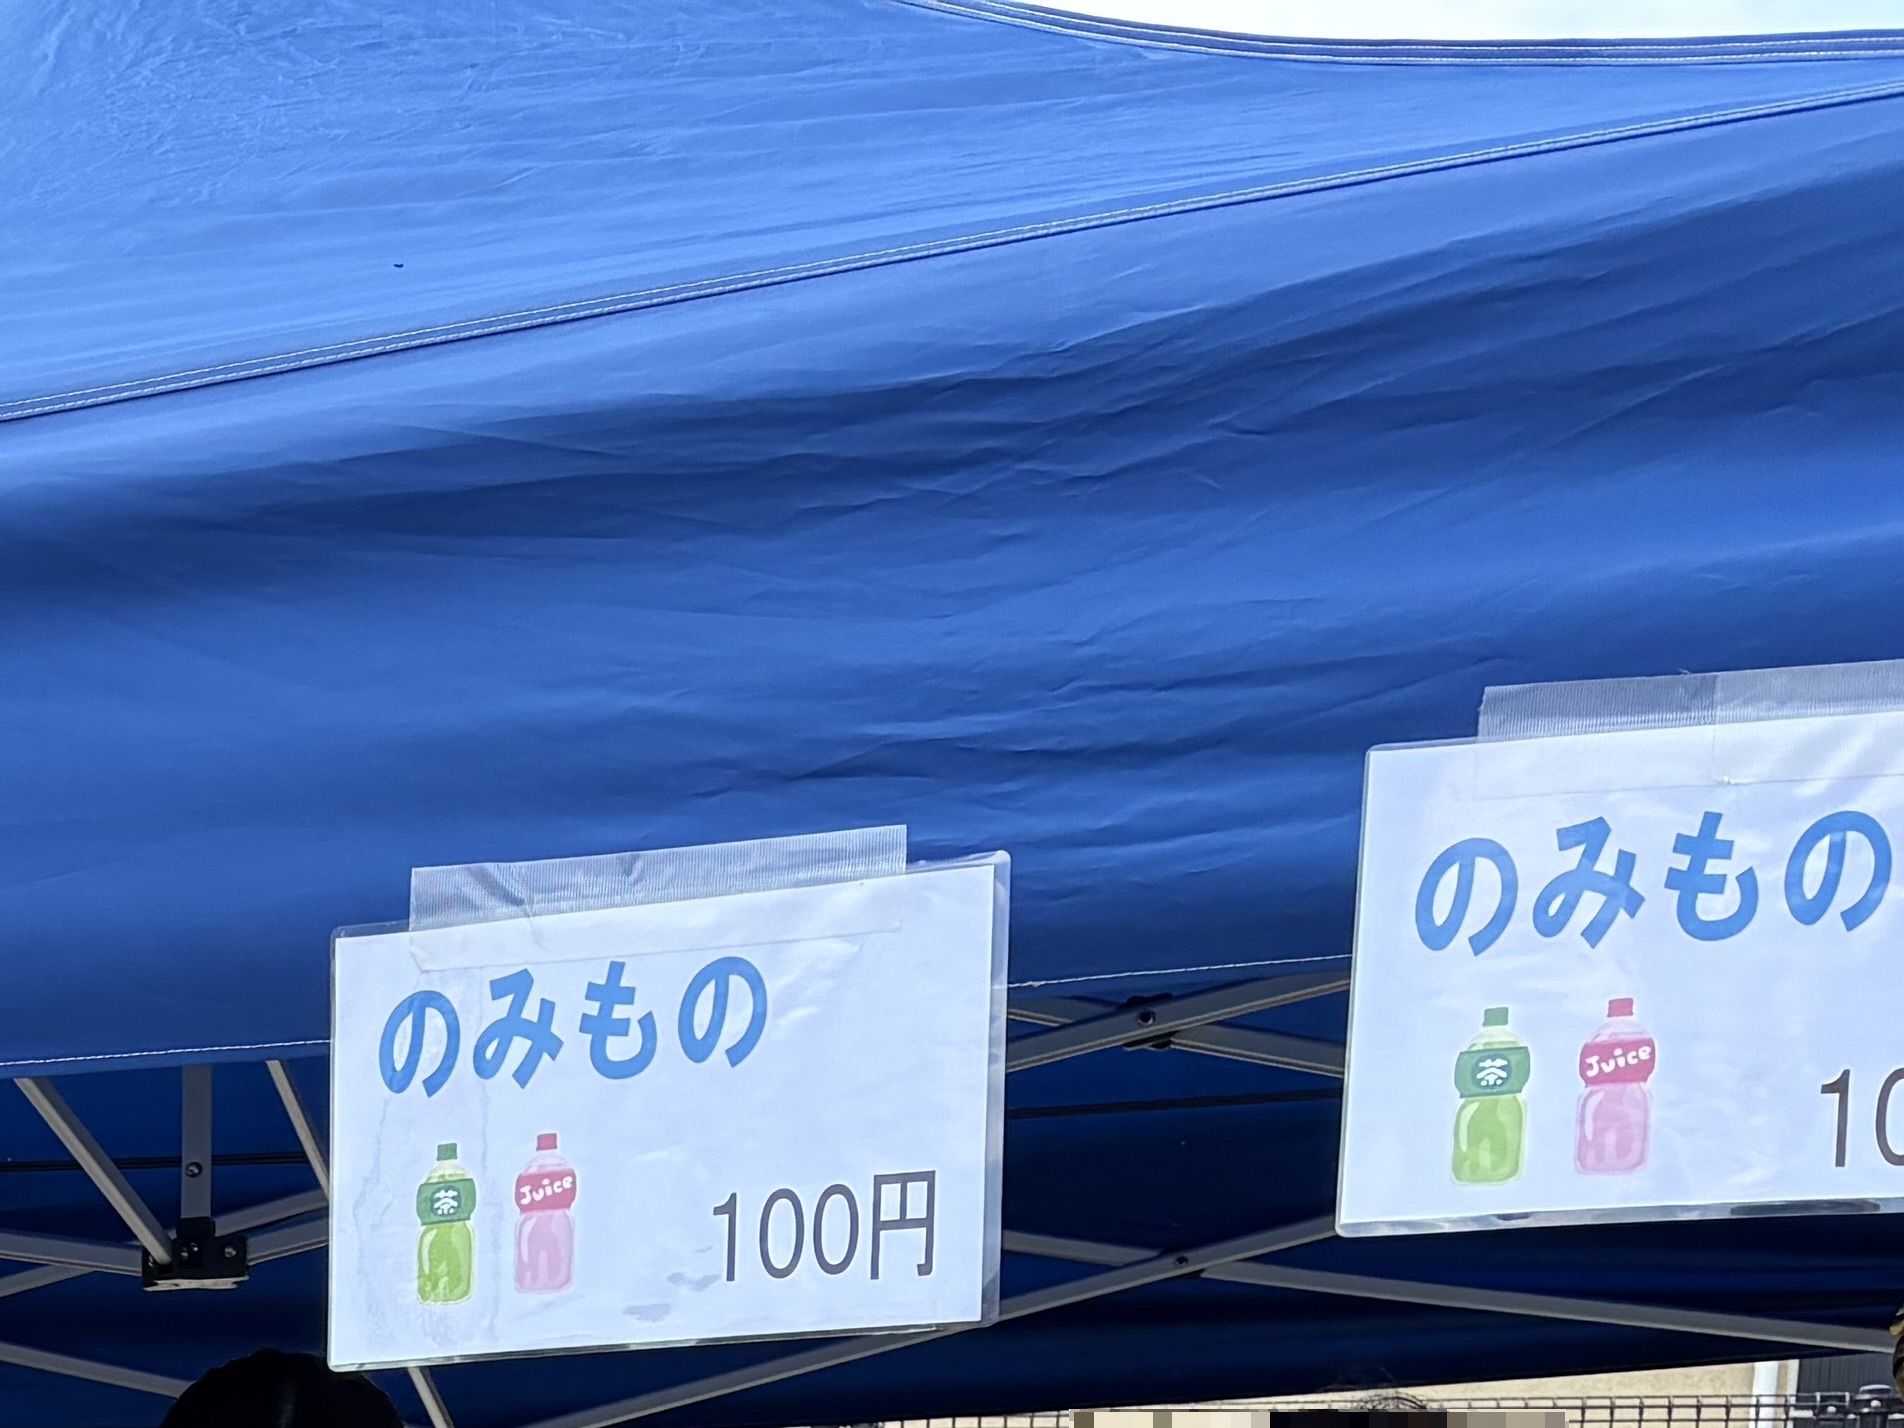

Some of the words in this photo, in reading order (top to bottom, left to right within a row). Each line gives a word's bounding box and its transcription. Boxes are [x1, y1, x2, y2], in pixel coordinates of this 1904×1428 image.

[1415, 811, 1892, 957] のみもの
[379, 955, 769, 1098] のみもの
[1585, 1046, 1652, 1078] Juice
[520, 1176, 573, 1205] Juice
[712, 1169, 937, 1282] 100円
